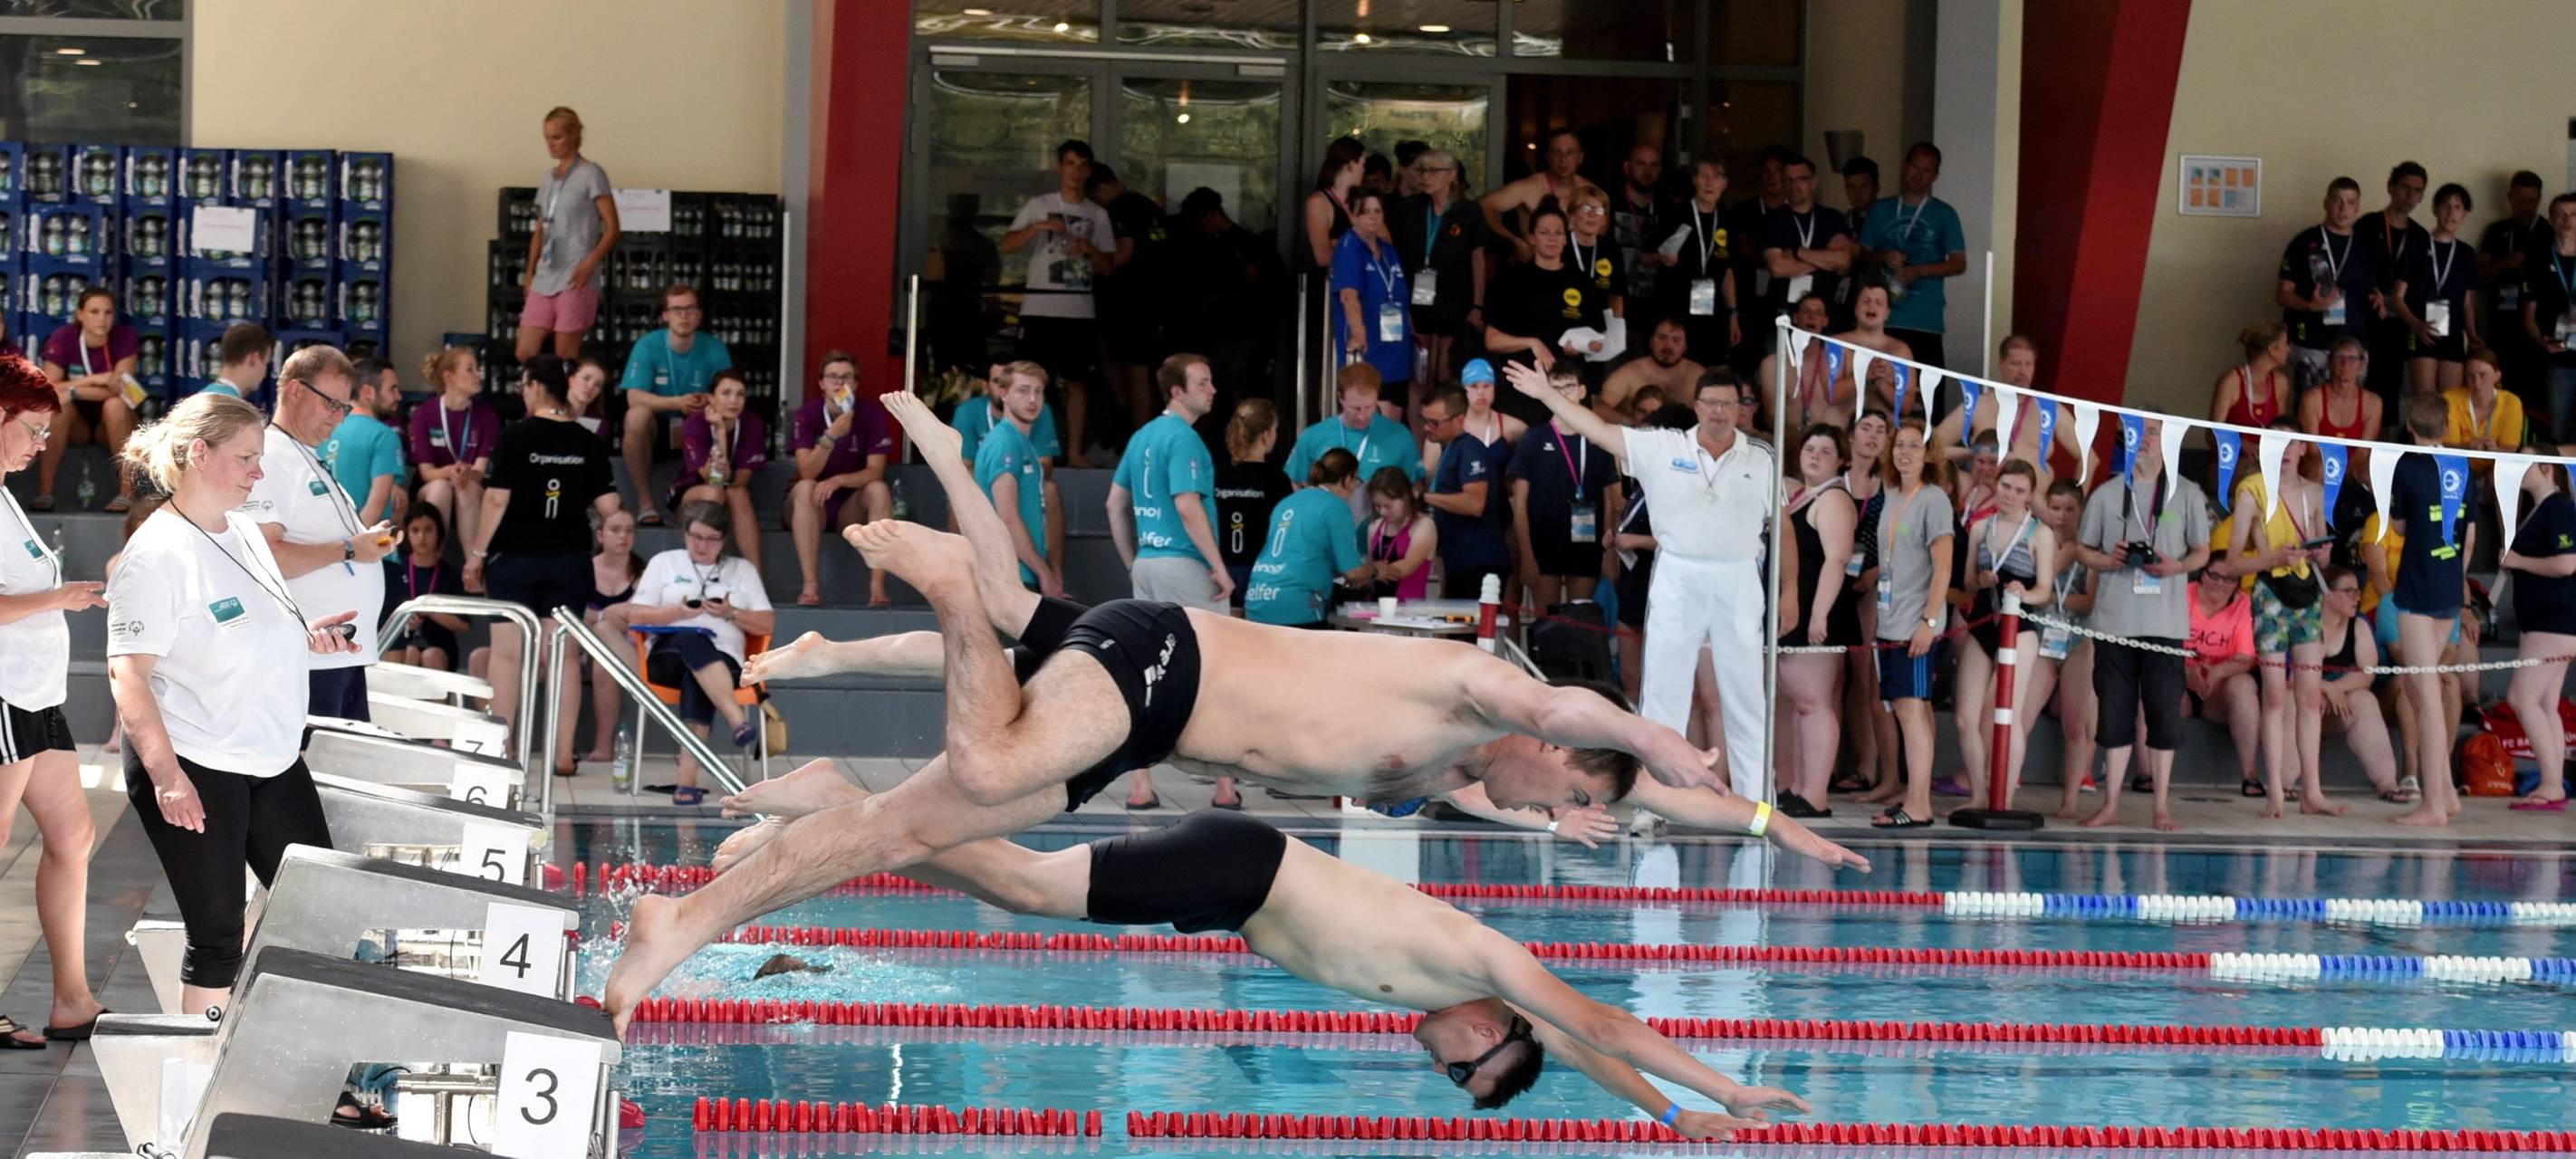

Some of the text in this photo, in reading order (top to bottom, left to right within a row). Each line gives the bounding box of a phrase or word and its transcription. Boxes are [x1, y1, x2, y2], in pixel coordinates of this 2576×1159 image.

[529, 452, 585, 465] Organisation
[1245, 582, 1282, 602] elfer
[2189, 627, 2232, 648] EACH
[465, 739, 485, 754] 7
[466, 785, 487, 806] 6
[480, 848, 506, 883] 5
[499, 933, 532, 979] 4
[520, 1068, 559, 1125] 3
